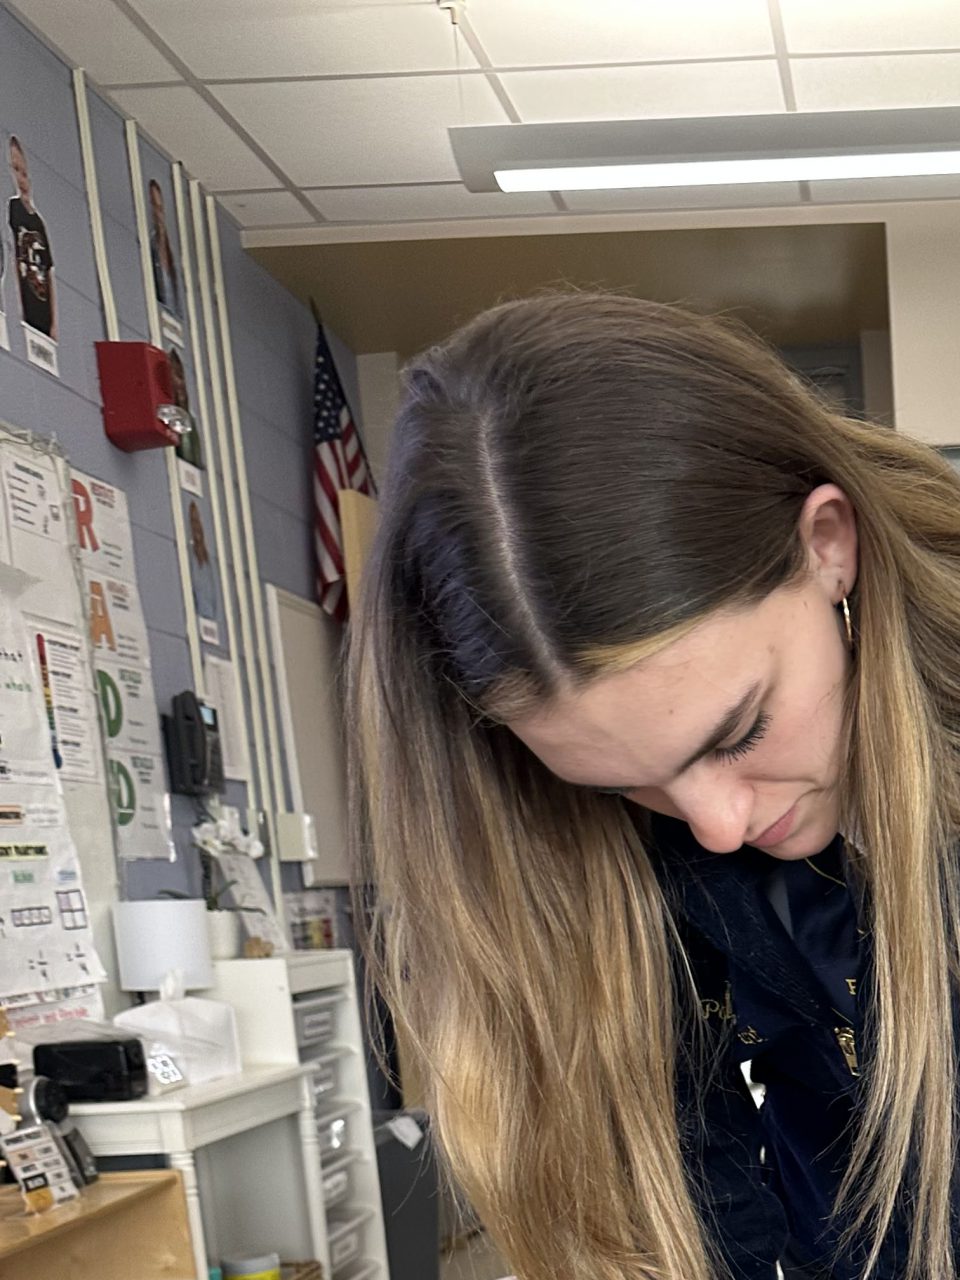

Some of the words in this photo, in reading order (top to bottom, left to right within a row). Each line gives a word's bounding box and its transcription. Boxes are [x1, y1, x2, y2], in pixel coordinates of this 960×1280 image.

[71, 478, 100, 553] R
[89, 580, 117, 652] A
[97, 669, 123, 738] D
